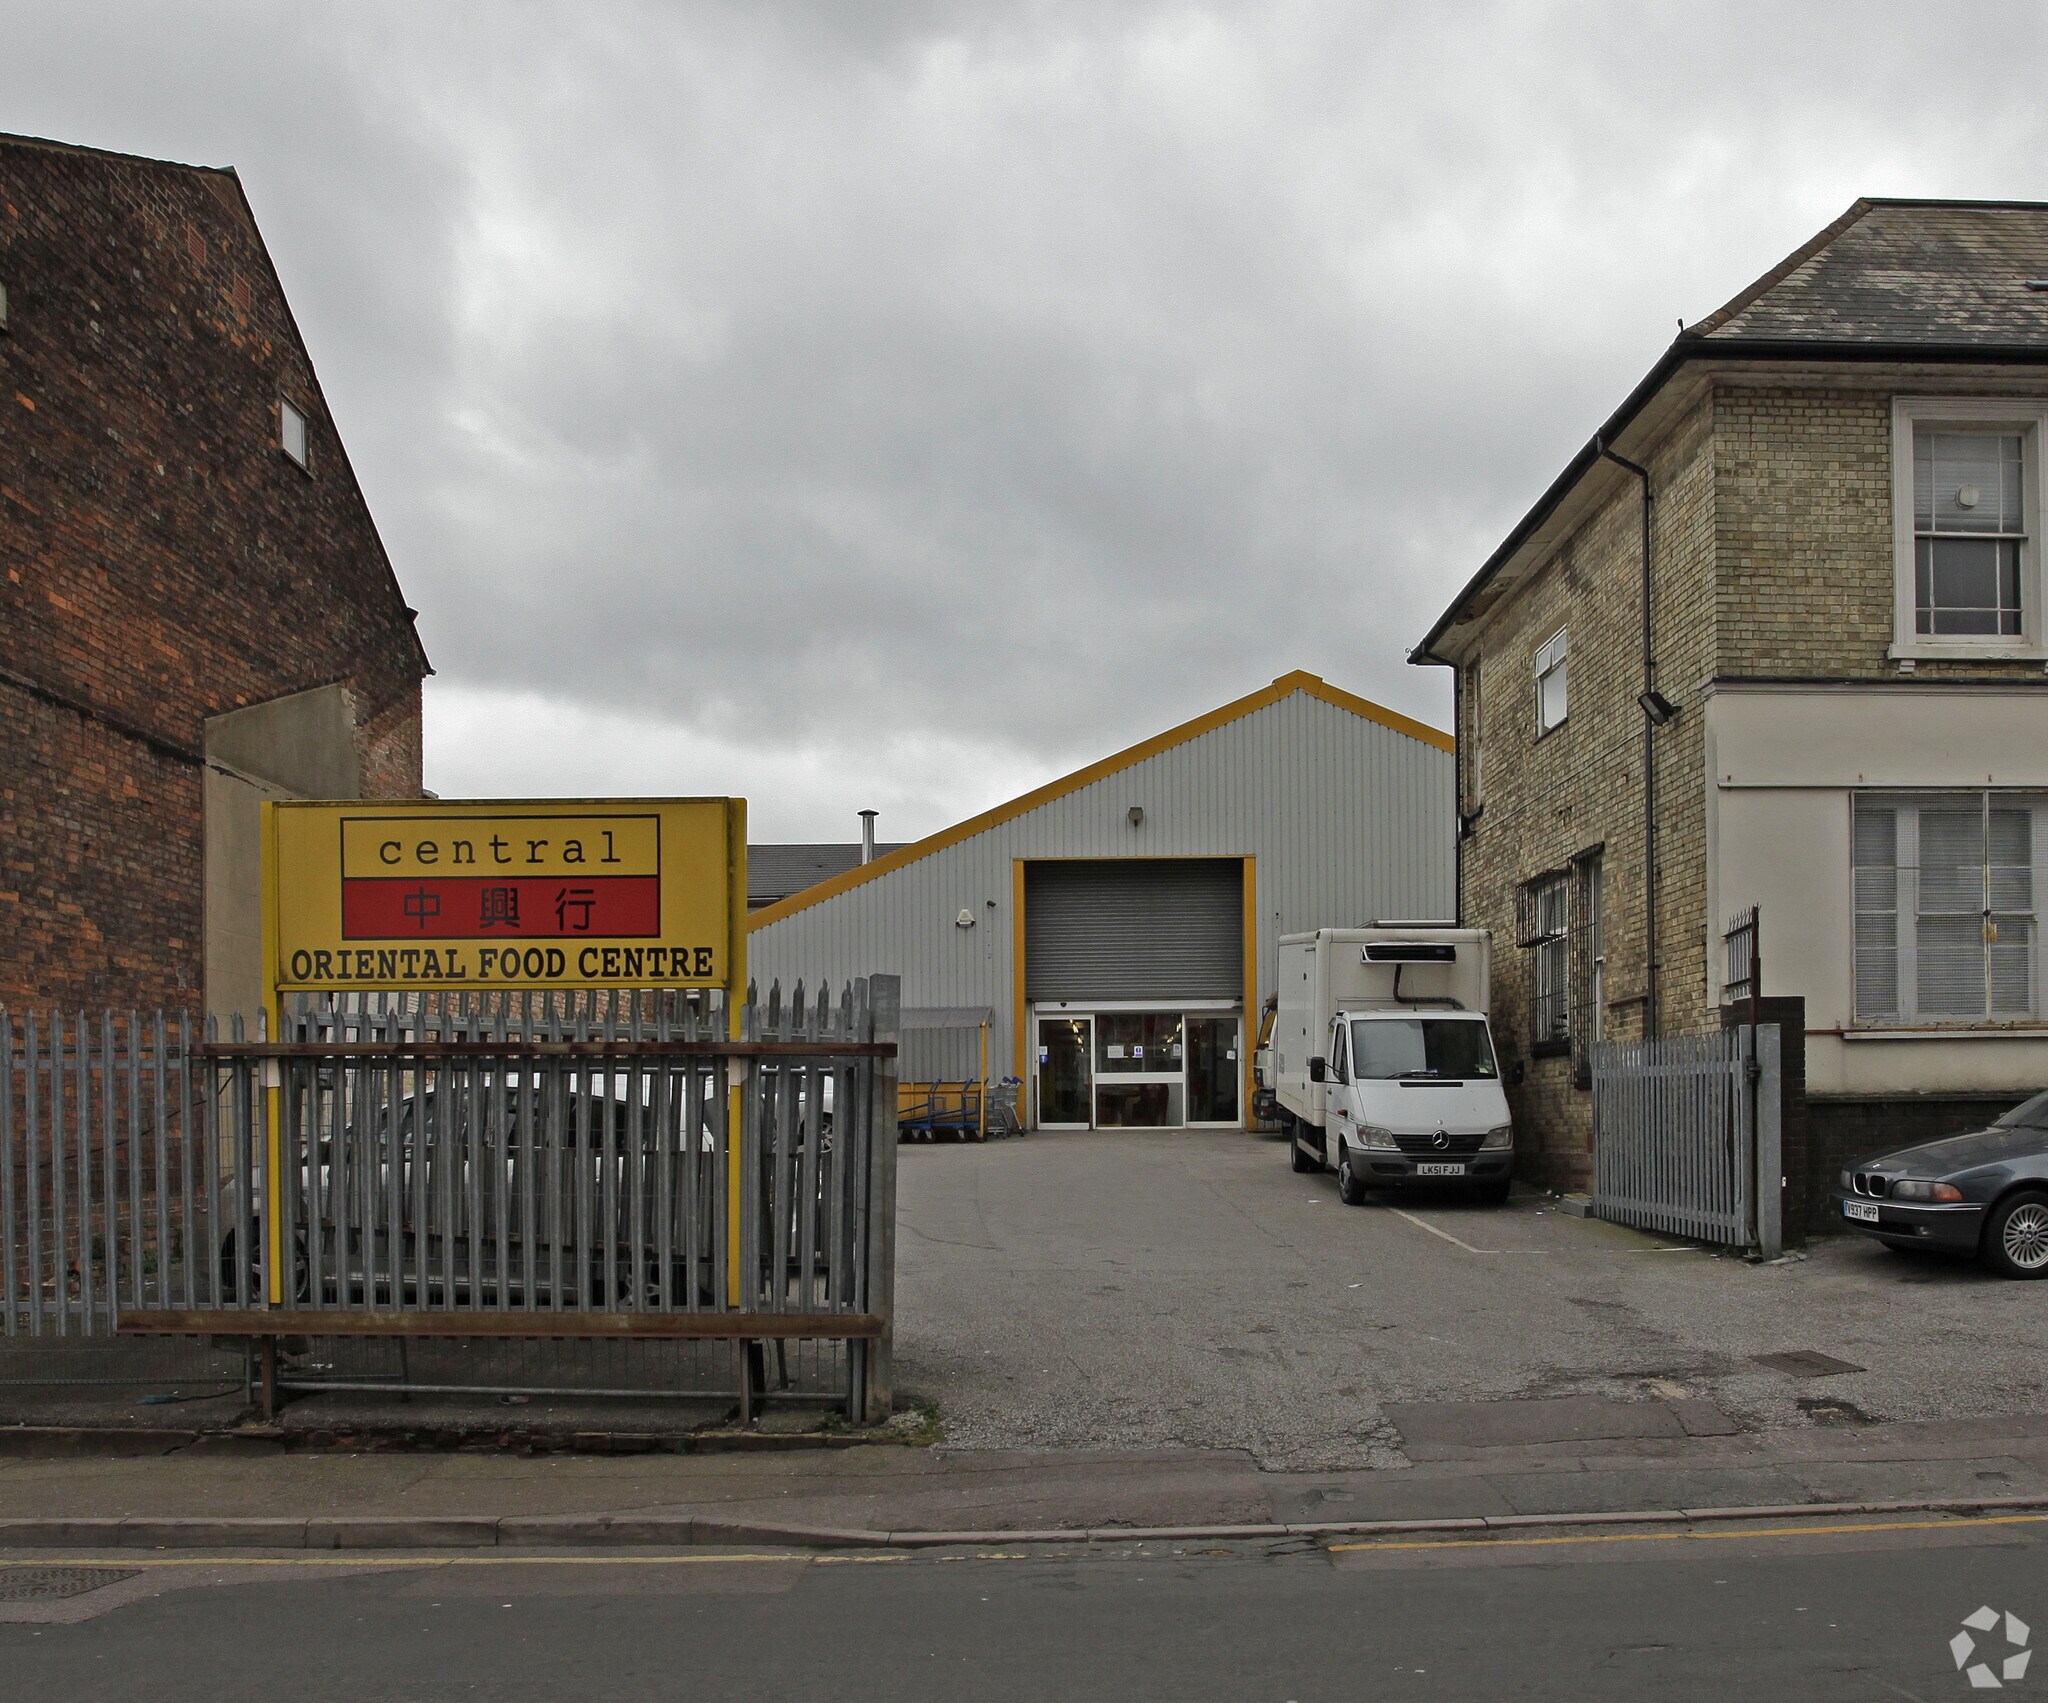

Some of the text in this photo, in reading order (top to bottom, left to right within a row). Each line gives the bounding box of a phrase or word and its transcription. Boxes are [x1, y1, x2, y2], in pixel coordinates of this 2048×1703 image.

[379, 830, 621, 865] central
[403, 886, 596, 931] 中興行
[291, 946, 713, 981] ORIENTAL FOOD CENTRE
[1443, 1166, 1460, 1174] FJJ
